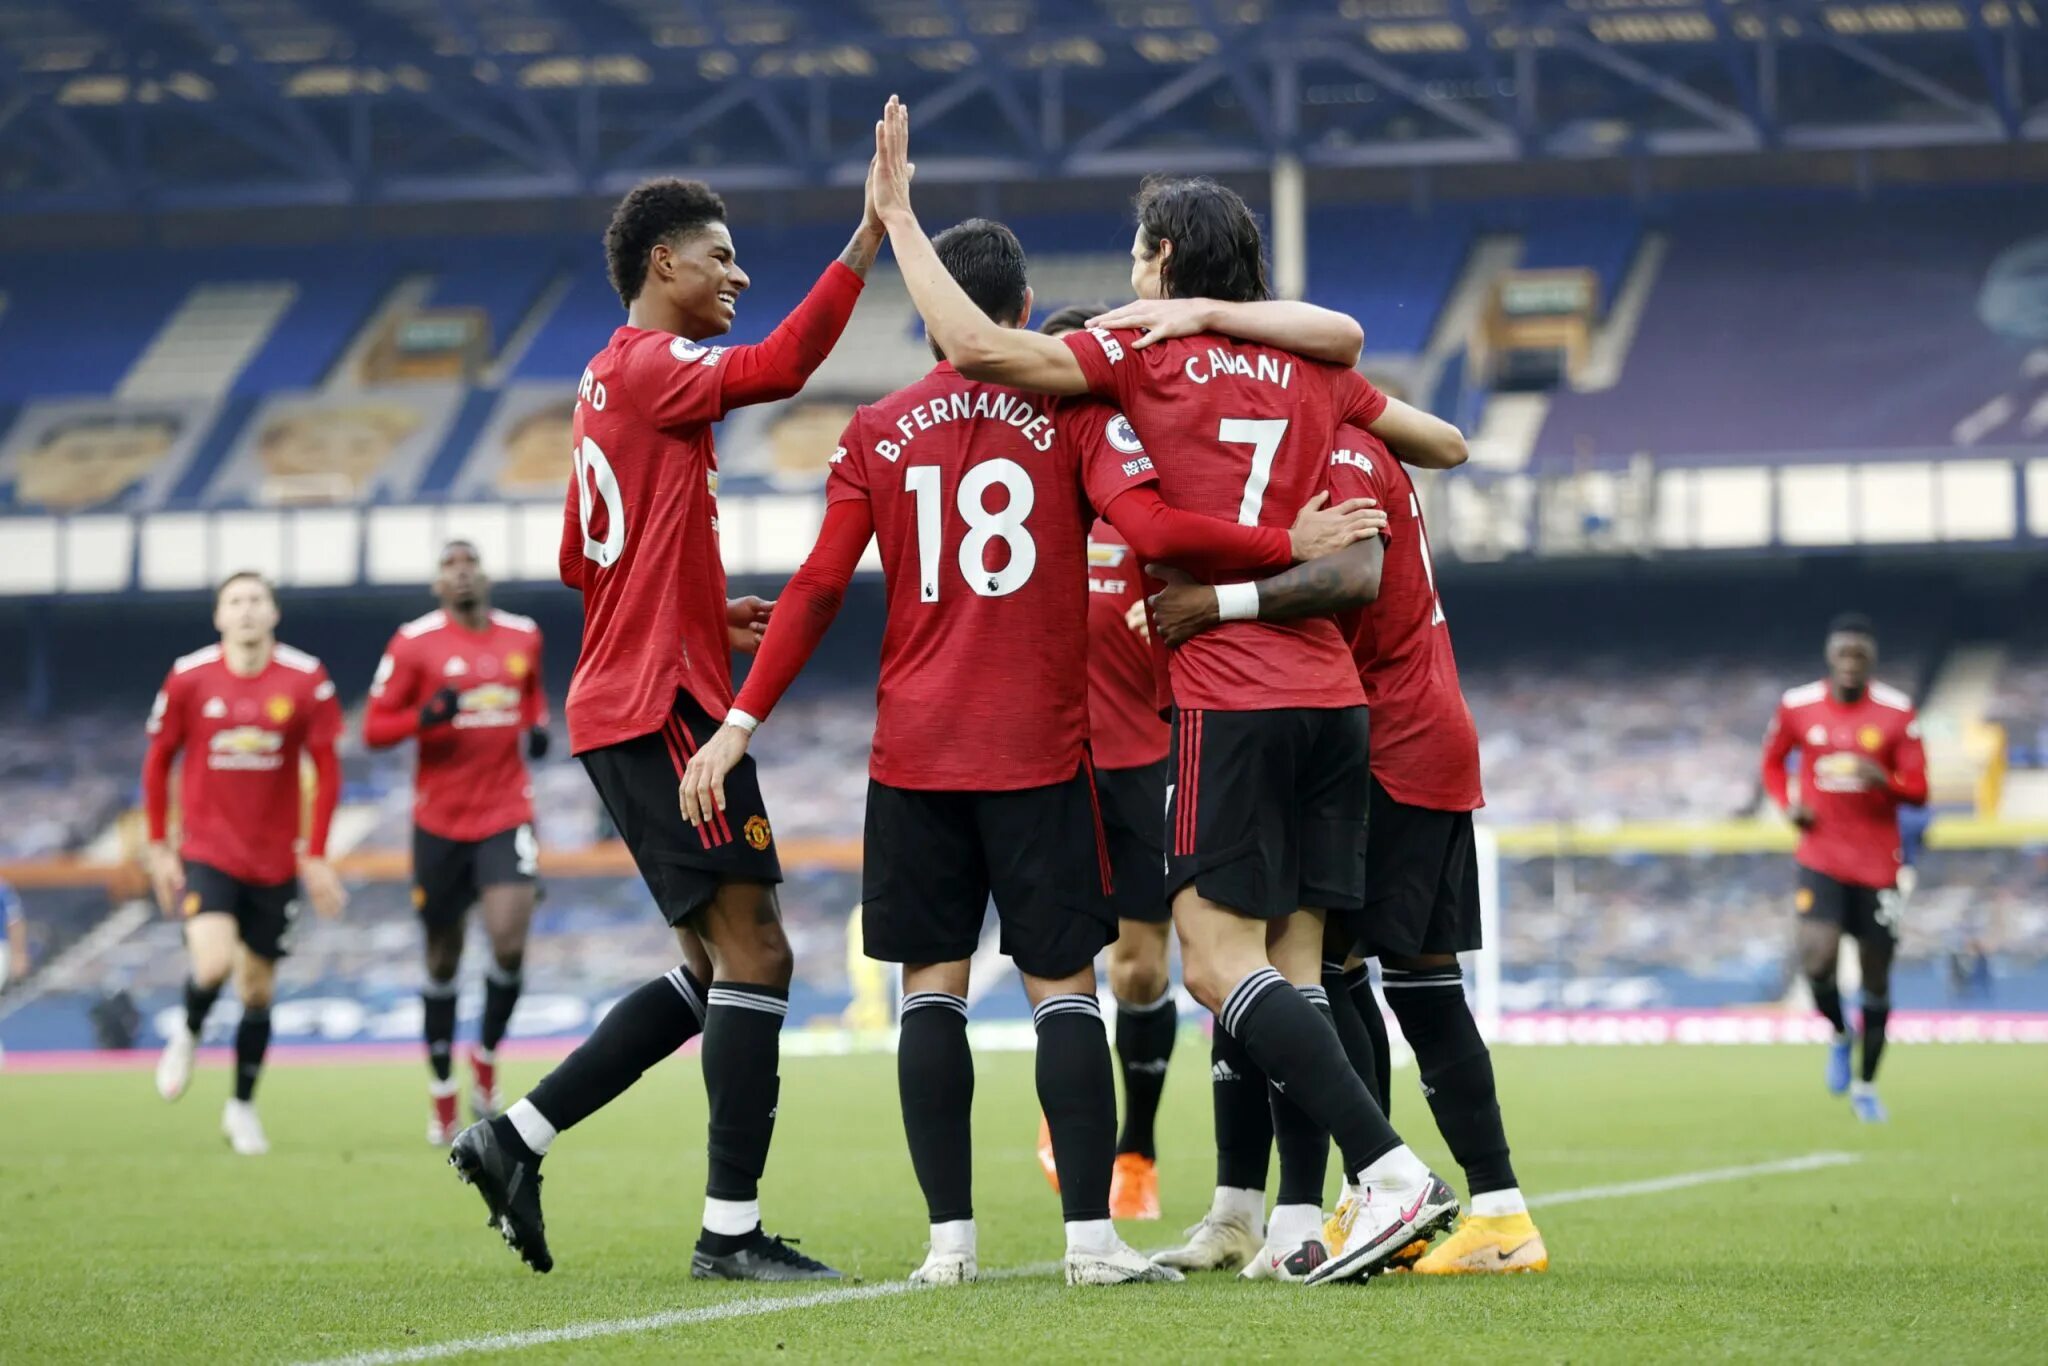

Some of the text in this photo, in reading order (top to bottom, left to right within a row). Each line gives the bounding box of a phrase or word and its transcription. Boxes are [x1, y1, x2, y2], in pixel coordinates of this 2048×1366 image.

[578, 366, 607, 412] RD
[1185, 347, 1292, 389] CAVANI
[875, 392, 1055, 463] B.FERNANDES
[1218, 418, 1289, 527] 7
[905, 457, 1037, 603] 18
